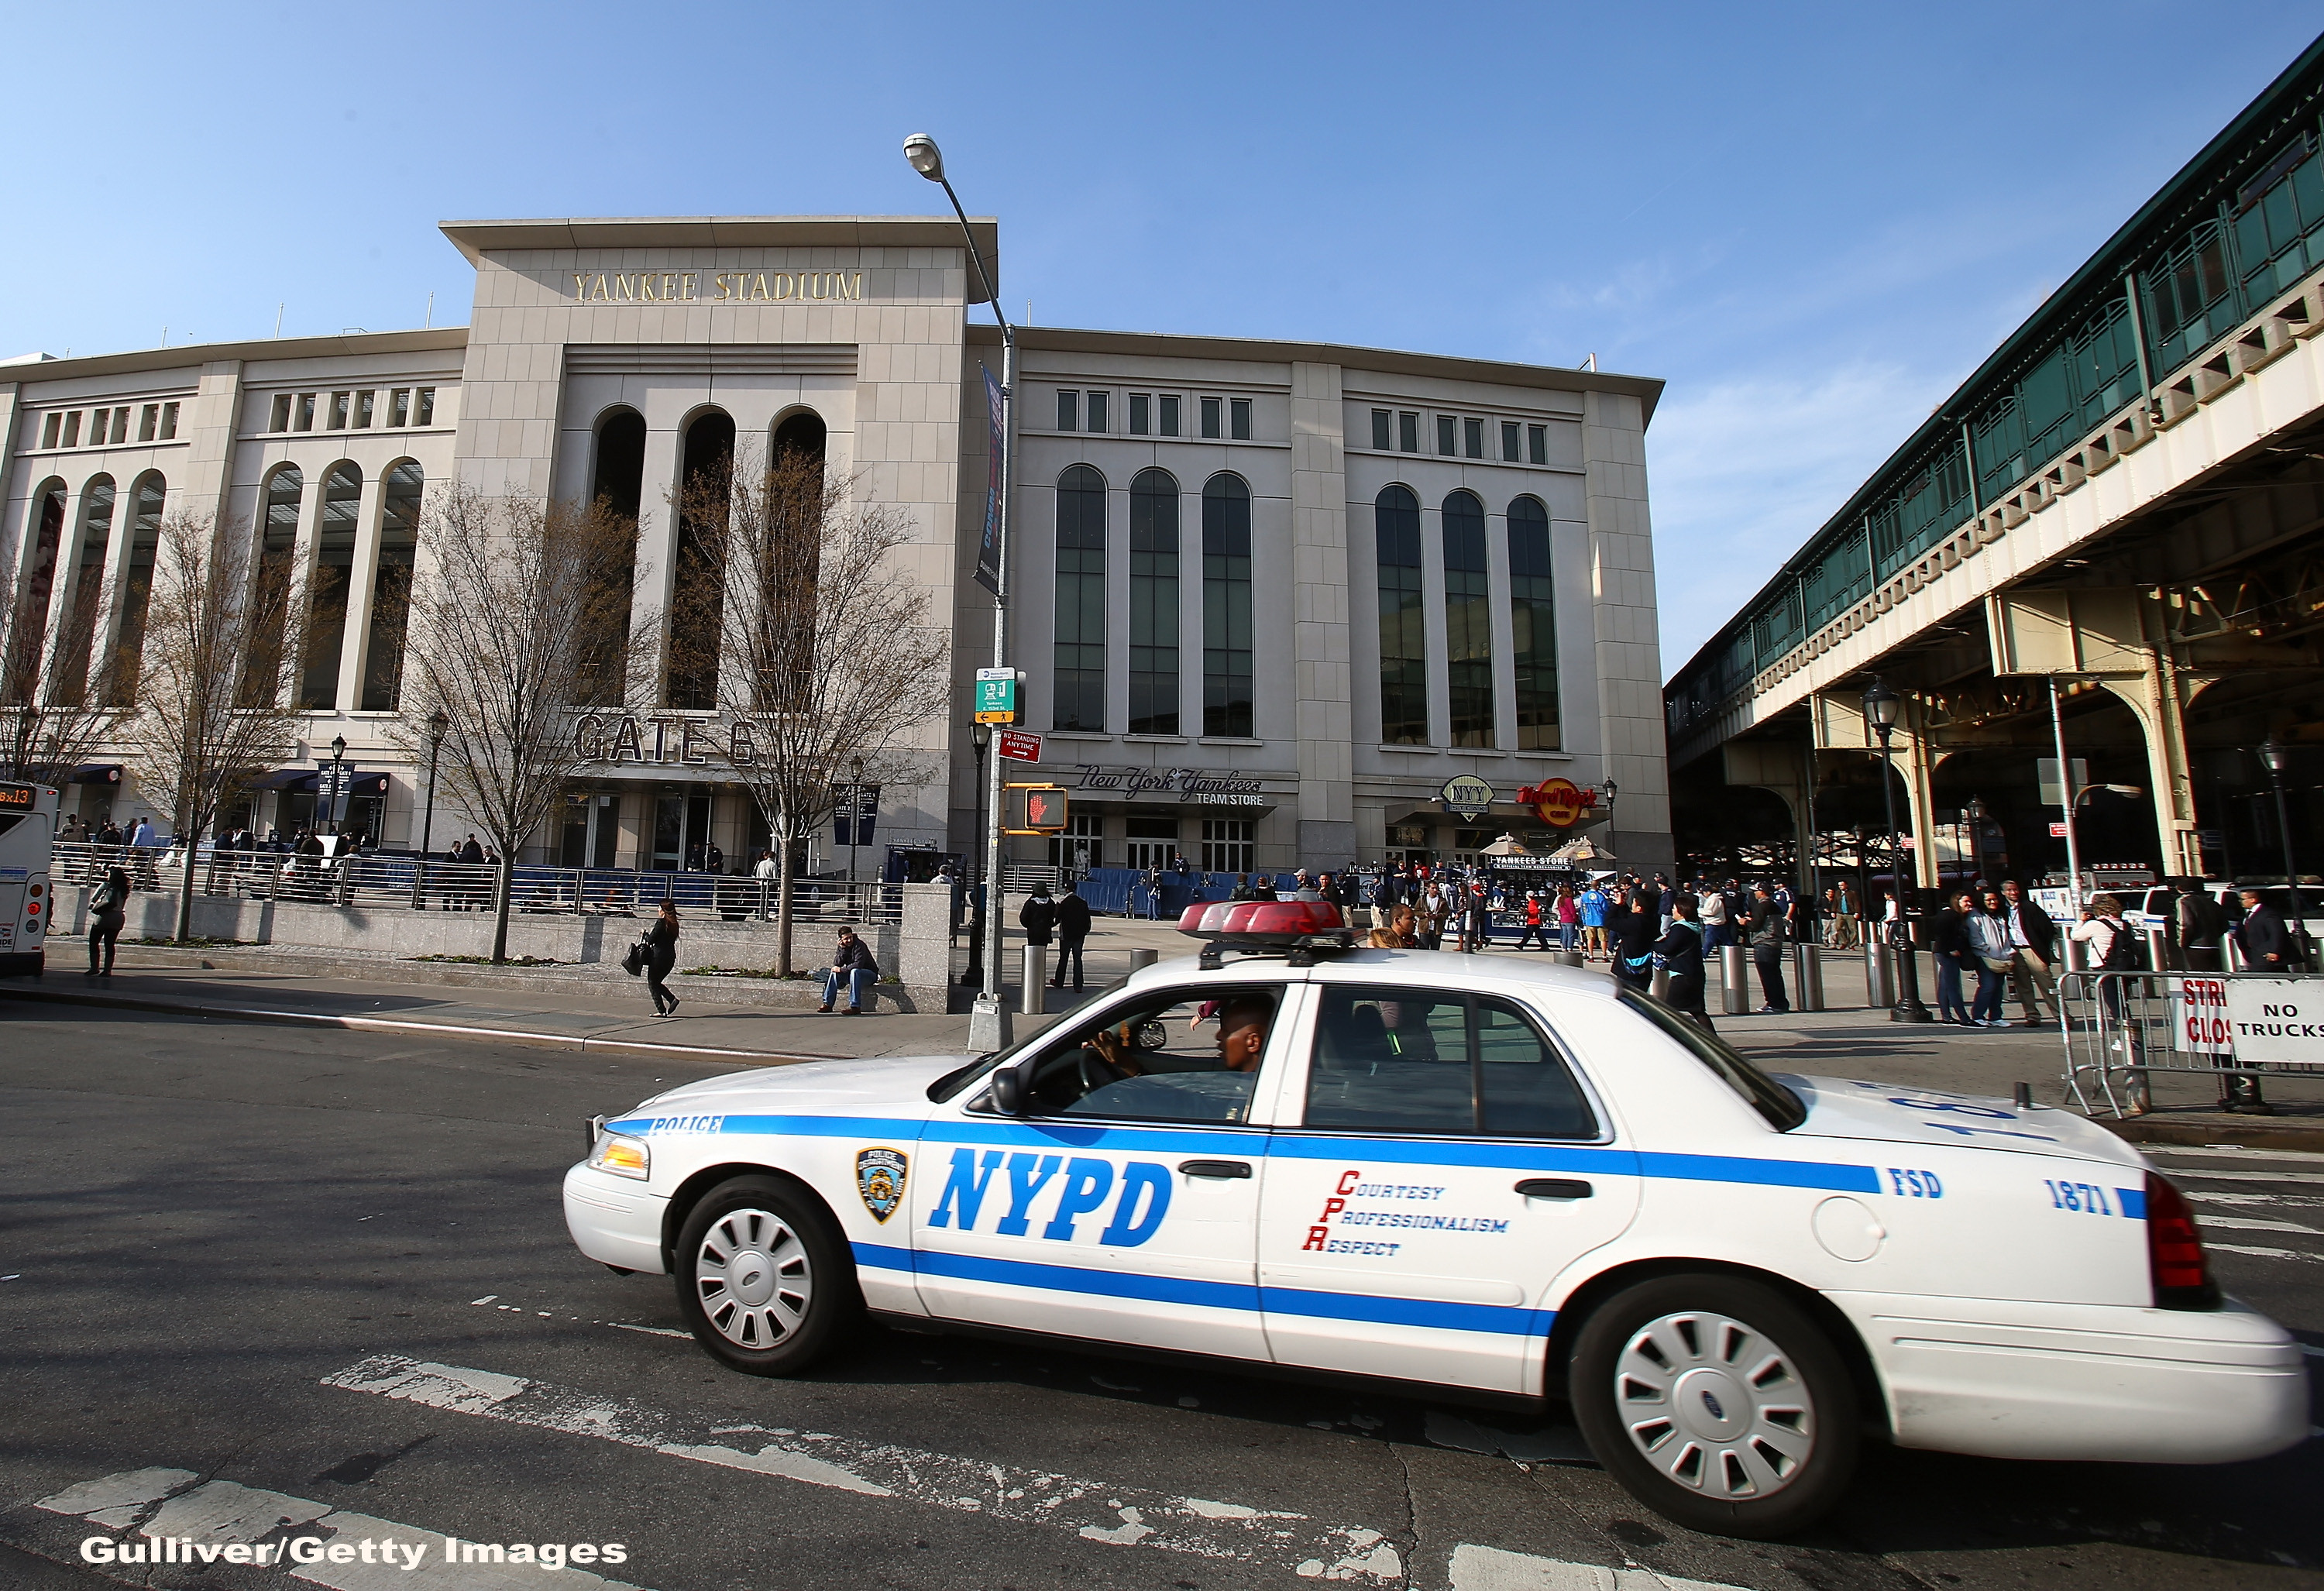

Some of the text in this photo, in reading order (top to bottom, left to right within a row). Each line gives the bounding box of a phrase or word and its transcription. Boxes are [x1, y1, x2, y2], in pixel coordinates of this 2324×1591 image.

[572, 273, 863, 301] YANKEE STADIUM
[573, 713, 758, 766] GATE 6
[1006, 741, 1034, 751] ANYTIME
[1012, 734, 1040, 744] STANDING
[1074, 764, 1263, 802] New York Yankees
[1450, 784, 1486, 802] NYY
[1195, 792, 1263, 806] TEAM STORE
[1516, 786, 1598, 809] Hard Rock
[1495, 856, 1569, 865] YANKEES STORE
[2263, 1004, 2298, 1018] NO
[649, 1115, 725, 1136] POLICE
[858, 1158, 906, 1173] DEPARTMENT
[868, 1150, 897, 1161] POLICE
[1336, 1170, 1446, 1200] COURTESY
[1887, 1167, 1943, 1198] FSD
[929, 1147, 1173, 1248] NYPD
[2043, 1178, 2113, 1216] 1871
[1318, 1198, 1511, 1233] PROFESSIONALISM
[1301, 1225, 1401, 1256] RESPECT
